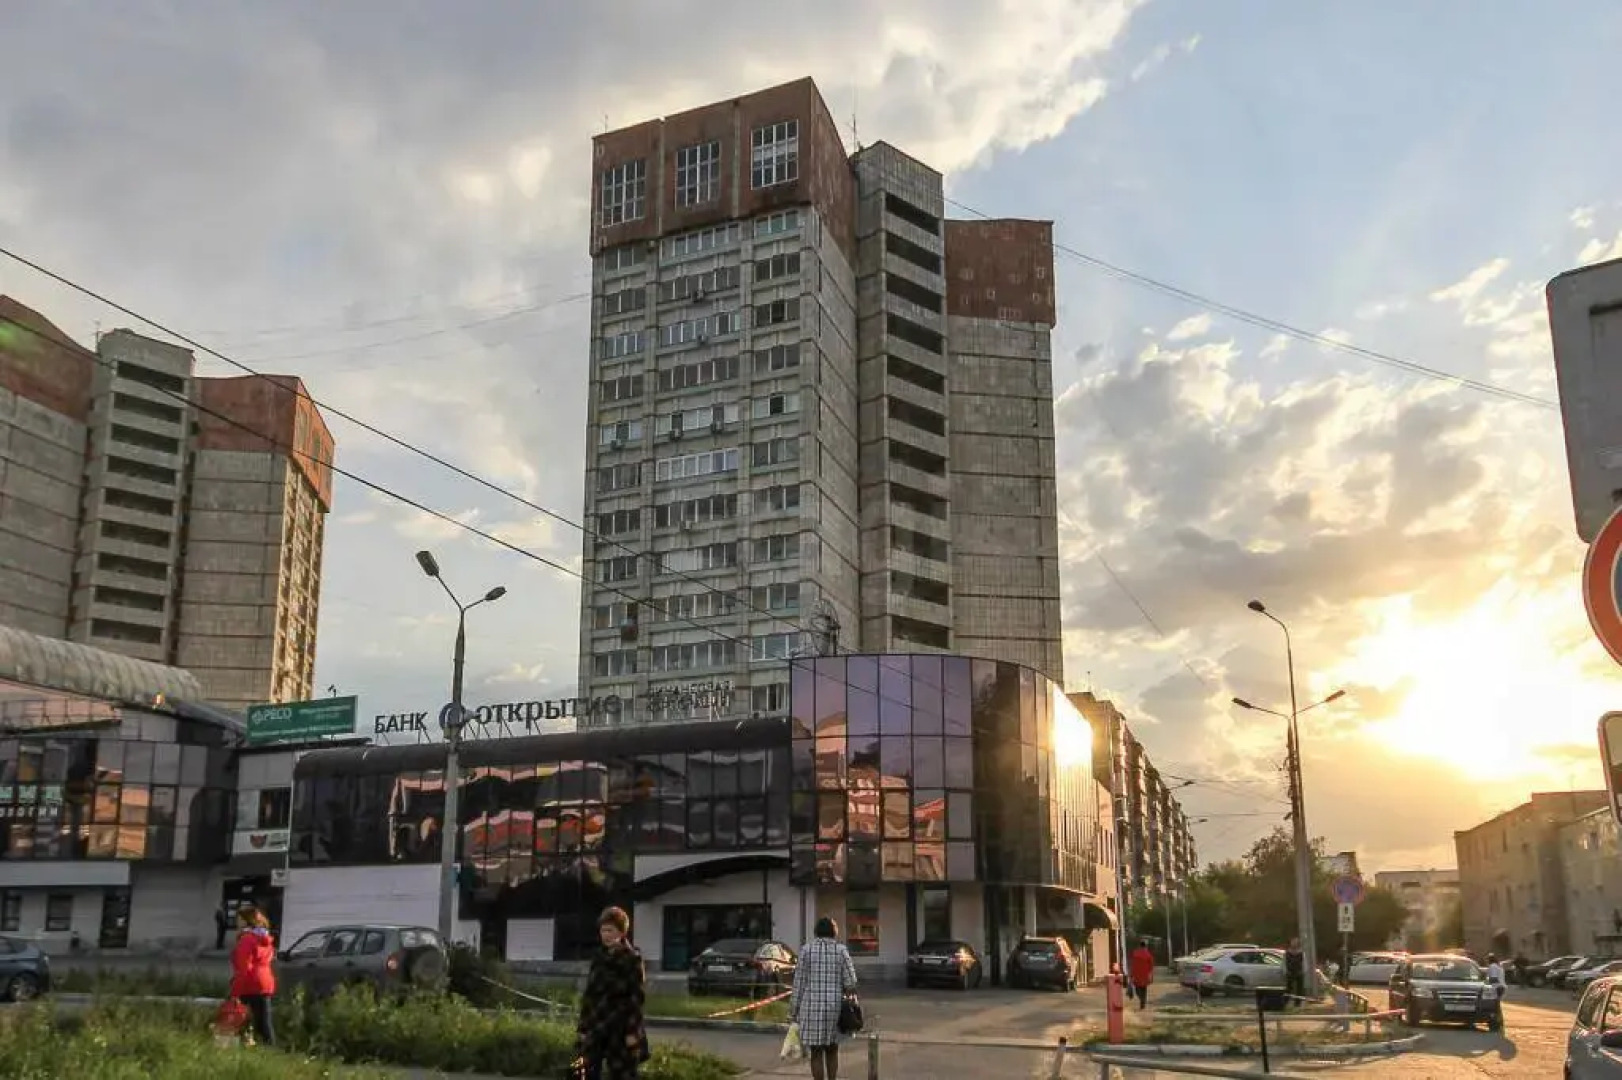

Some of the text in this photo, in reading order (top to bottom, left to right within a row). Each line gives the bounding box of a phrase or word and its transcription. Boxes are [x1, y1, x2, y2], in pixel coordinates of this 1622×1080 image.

[264, 707, 292, 721] РЕСО
[374, 711, 428, 734] БАНК
[475, 695, 622, 729] открытие
